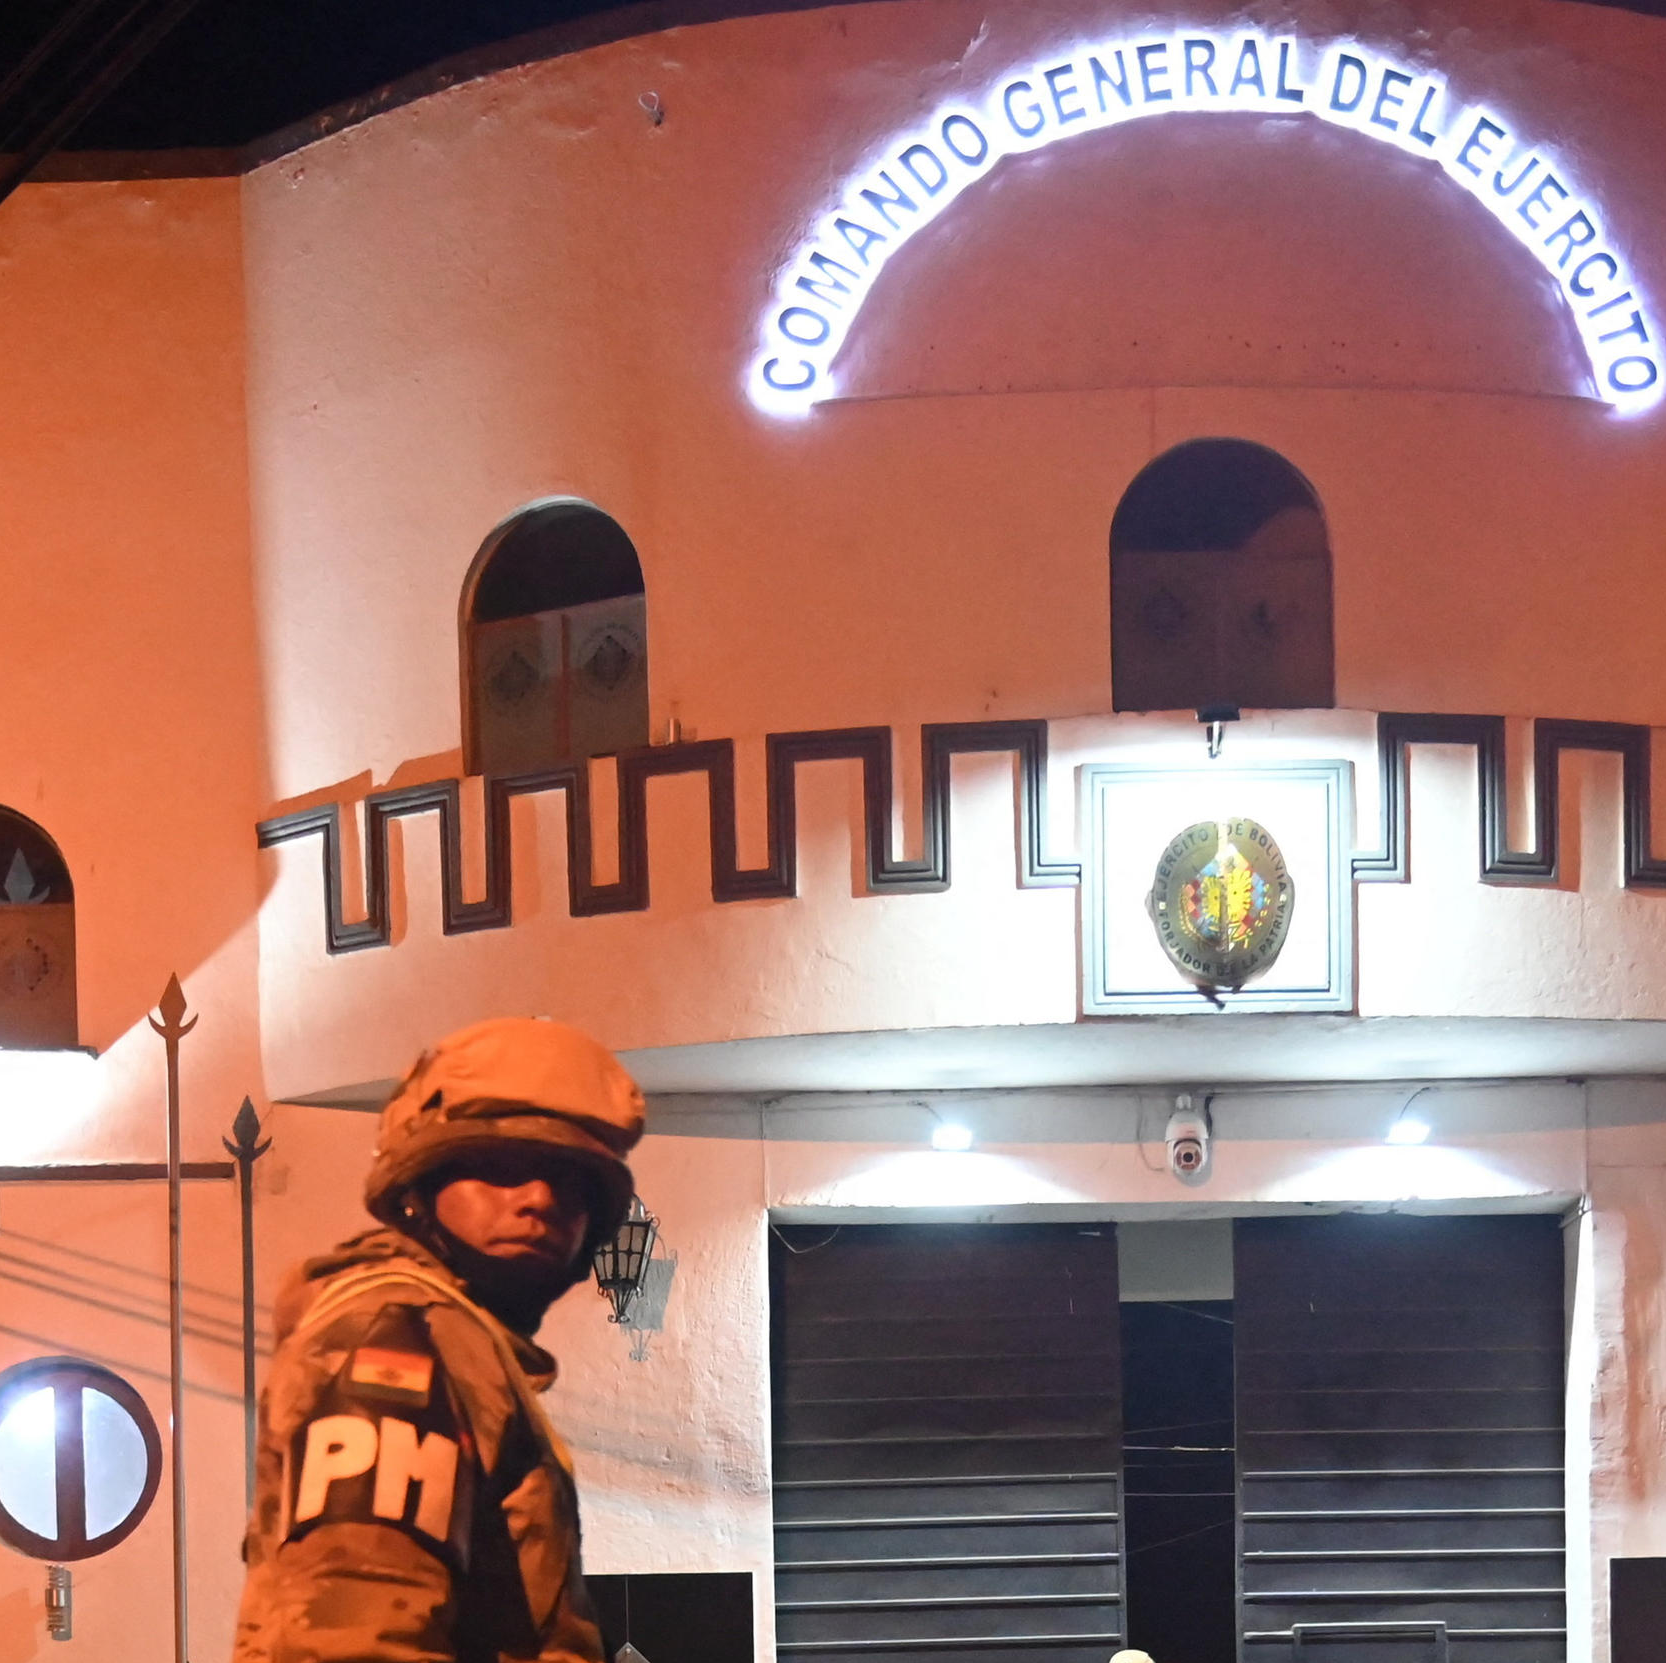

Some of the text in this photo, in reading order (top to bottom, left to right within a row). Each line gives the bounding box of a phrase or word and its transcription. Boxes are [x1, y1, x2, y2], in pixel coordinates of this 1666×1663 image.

[761, 38, 1659, 395] COMANDO GENERAL DEL EJERCITO
[1157, 829, 1208, 899] EJERCITO
[1250, 829, 1287, 892] BOLIVIA
[1158, 910, 1210, 974] FORJADOR
[1259, 905, 1287, 956] PATRIA
[296, 1414, 458, 1542] PM
